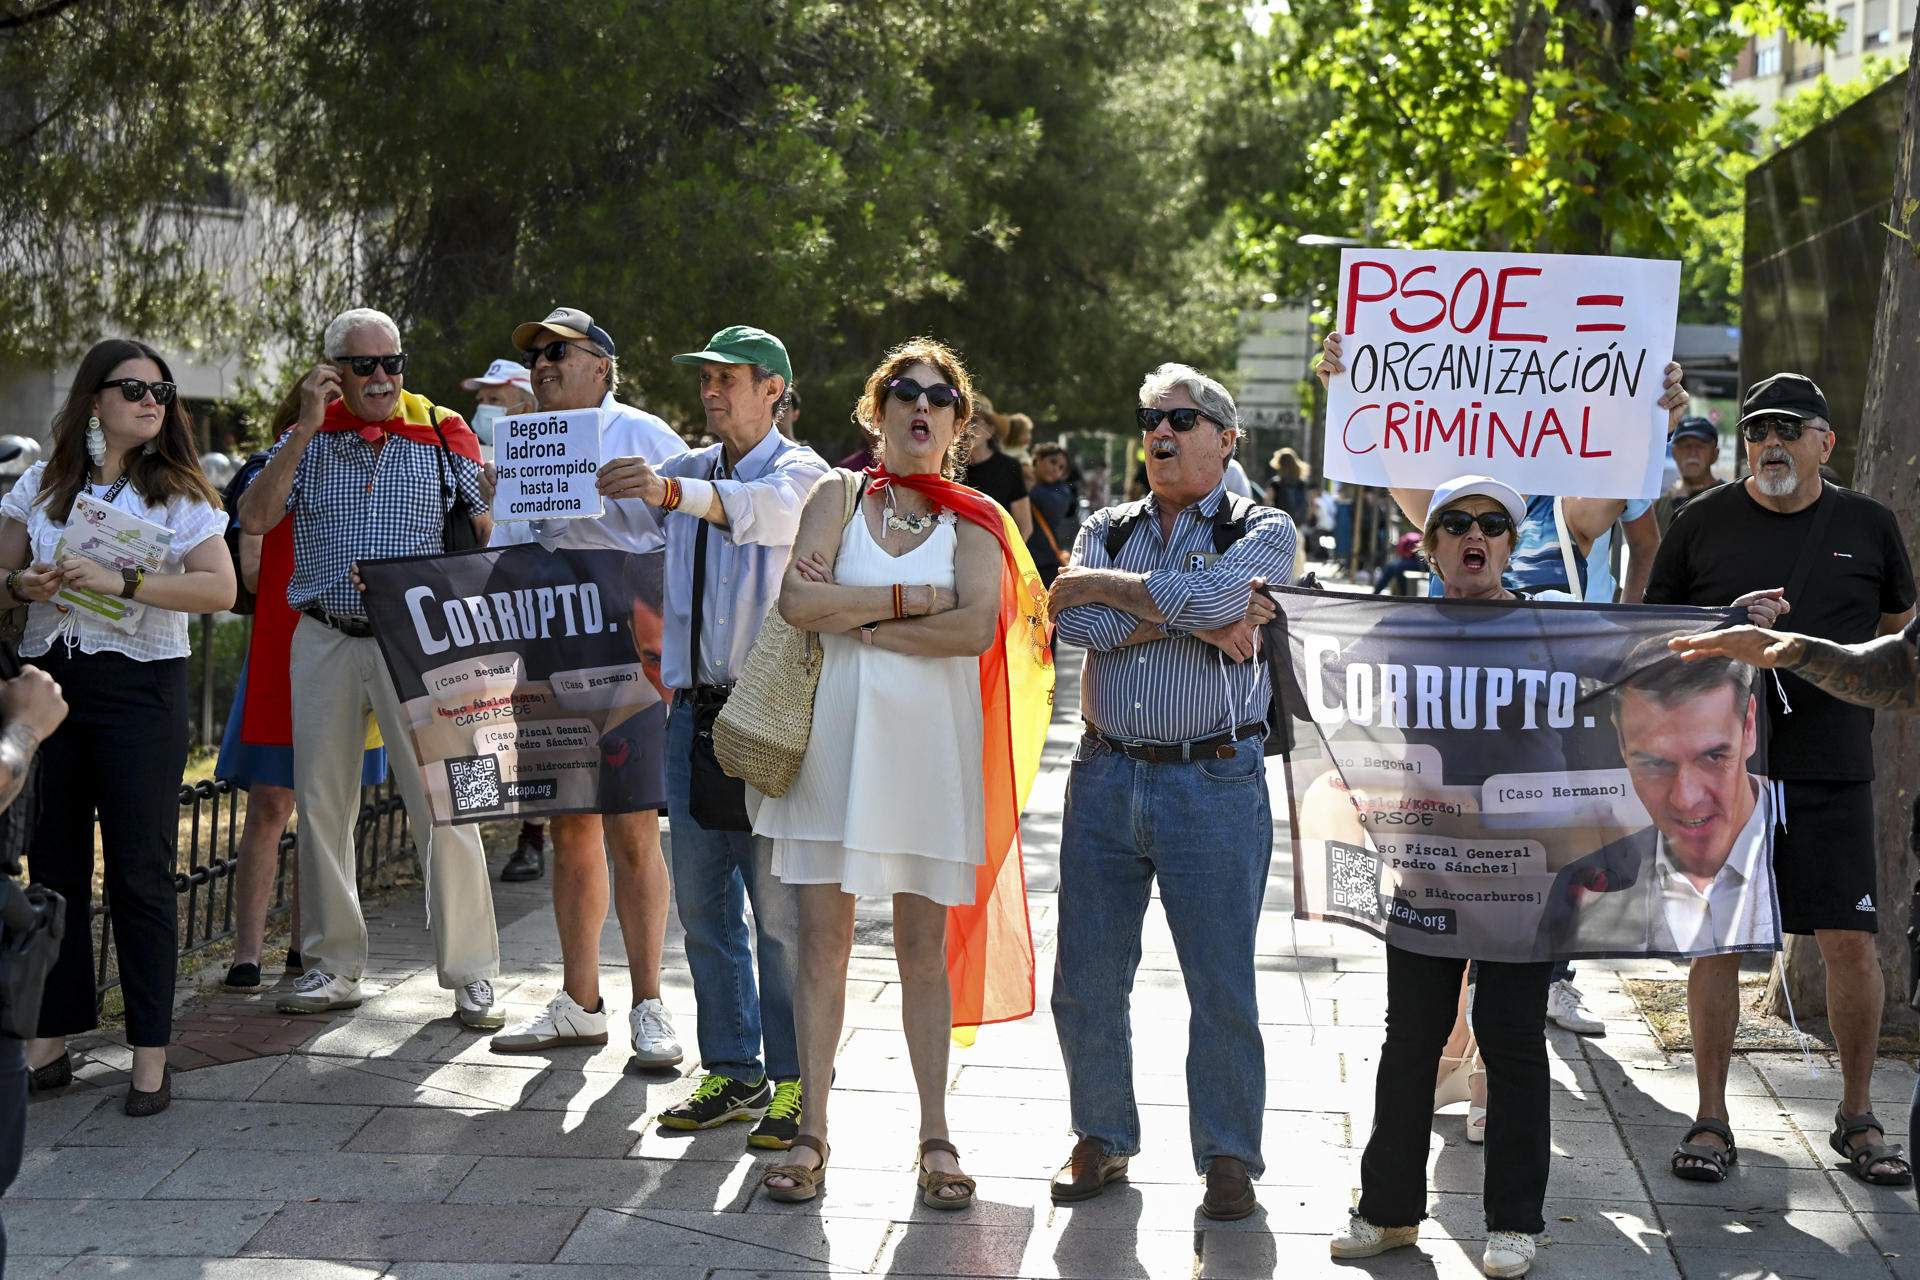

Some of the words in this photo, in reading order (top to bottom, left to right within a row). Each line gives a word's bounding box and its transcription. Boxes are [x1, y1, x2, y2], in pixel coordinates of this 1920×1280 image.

[1344, 260, 1549, 344] PSOE
[510, 416, 568, 441] Begoña
[506, 440, 566, 460] ladrona
[495, 464, 517, 480] Has
[520, 458, 597, 479] corrompido
[104, 474, 128, 503] SPACES
[520, 480, 554, 496] hasta
[557, 478, 569, 493] la
[510, 496, 581, 514] comadrona
[435, 673, 469, 691] [Caso
[560, 680, 584, 692] [Caso
[588, 671, 639, 688] Hermano]
[491, 703, 532, 719] PSOE
[485, 731, 515, 744] [Caso
[518, 725, 553, 738] Fiscal
[556, 724, 592, 736] General
[497, 742, 510, 753] de
[514, 740, 541, 751] Pedro
[545, 736, 589, 748] Sánchez]
[1363, 756, 1422, 774] Begoña]
[1499, 788, 1543, 803] [Caso
[1551, 783, 1626, 798] Hermano]
[1373, 810, 1435, 827] PSOE
[1405, 843, 1459, 858] Fiscal
[1466, 846, 1531, 860] General
[1392, 858, 1436, 871] Pedro
[1444, 861, 1518, 875] Sánchez]
[1425, 887, 1542, 905] Hidrocarburos]
